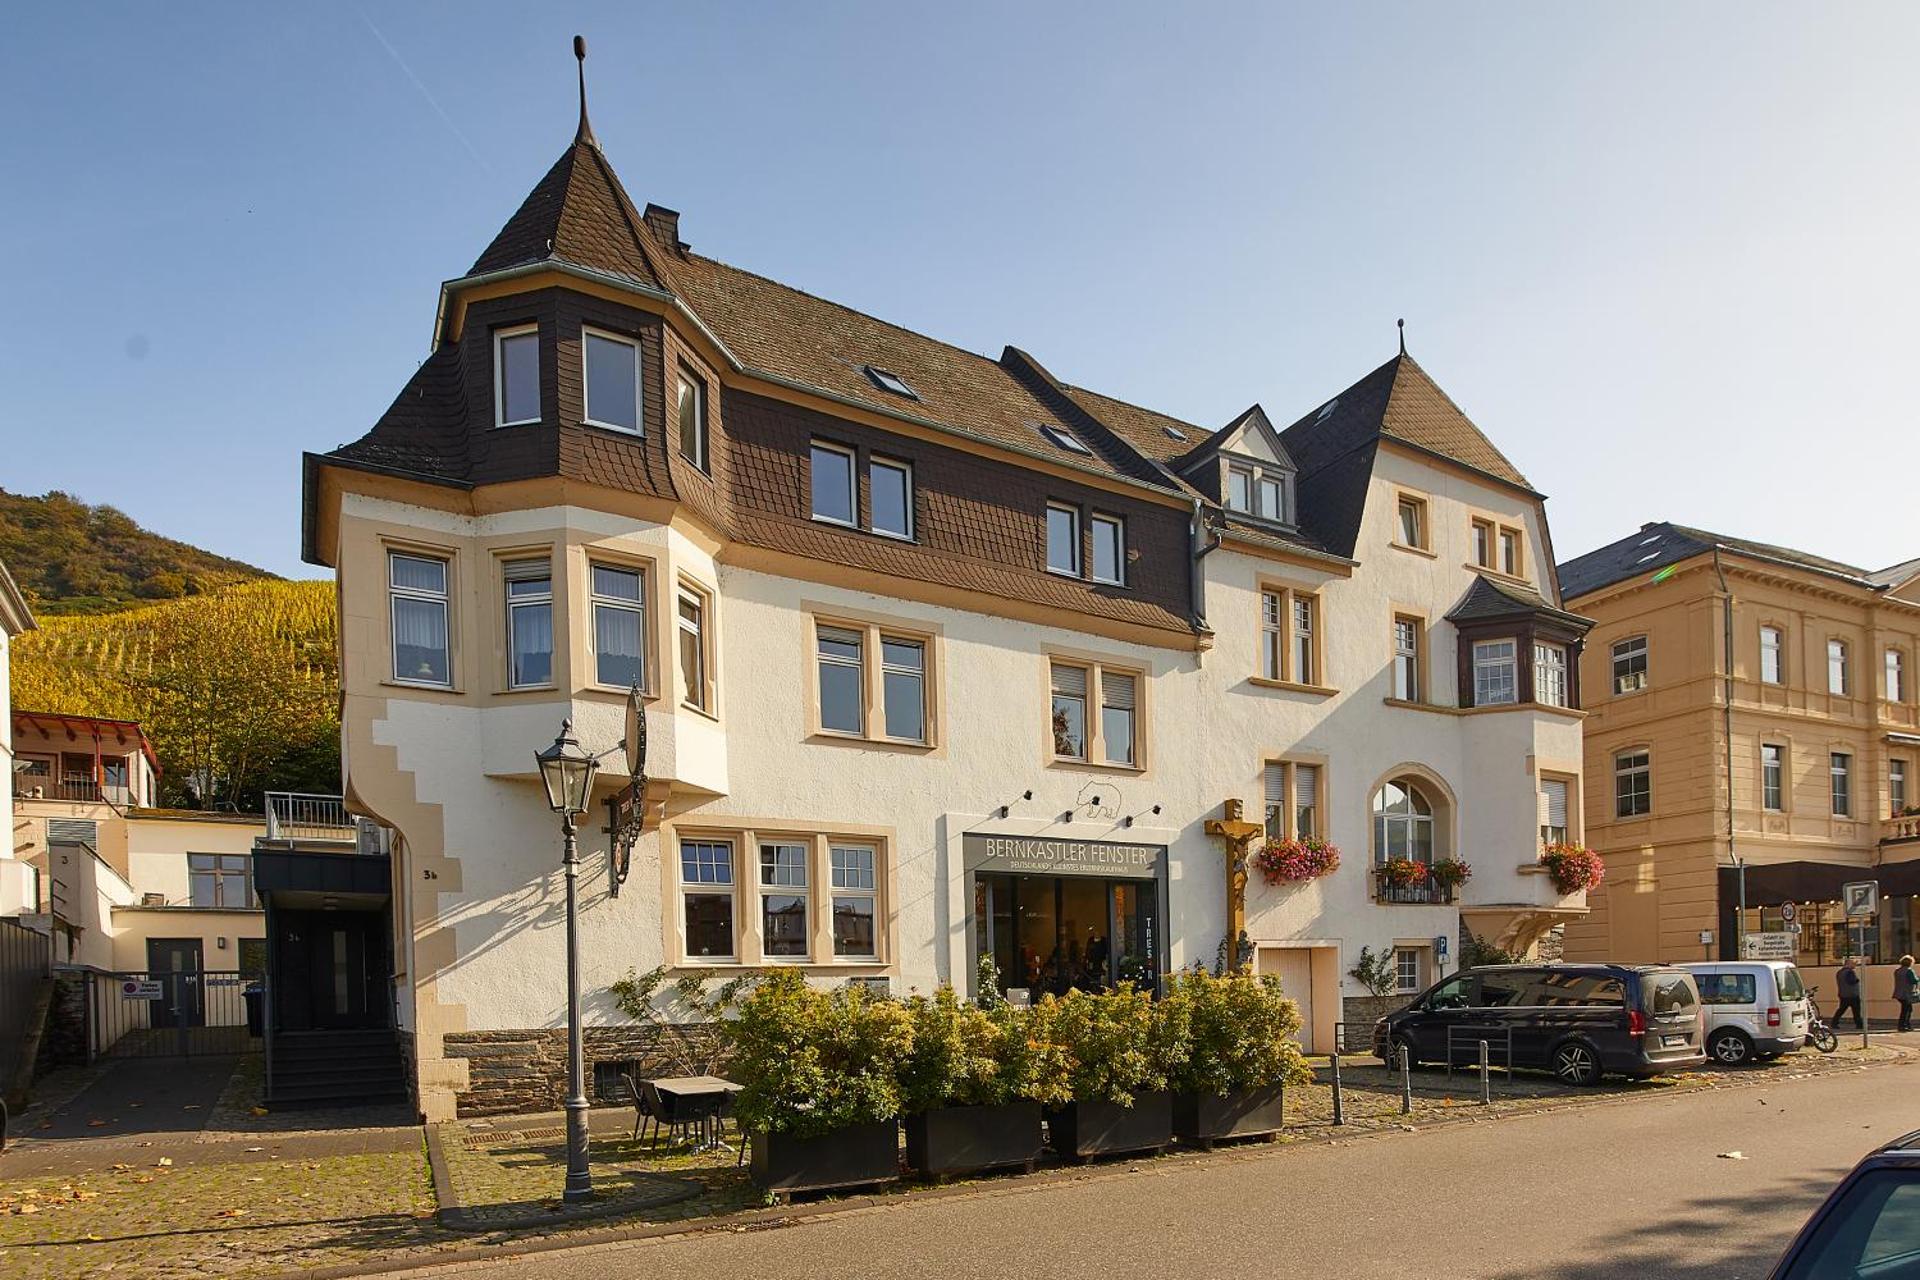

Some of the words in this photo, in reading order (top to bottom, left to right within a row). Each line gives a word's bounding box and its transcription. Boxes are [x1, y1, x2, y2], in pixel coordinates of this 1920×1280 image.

[61, 855, 69, 865] 3
[986, 838, 1087, 861] BERNKASTLER
[1091, 843, 1148, 865] FENSTER
